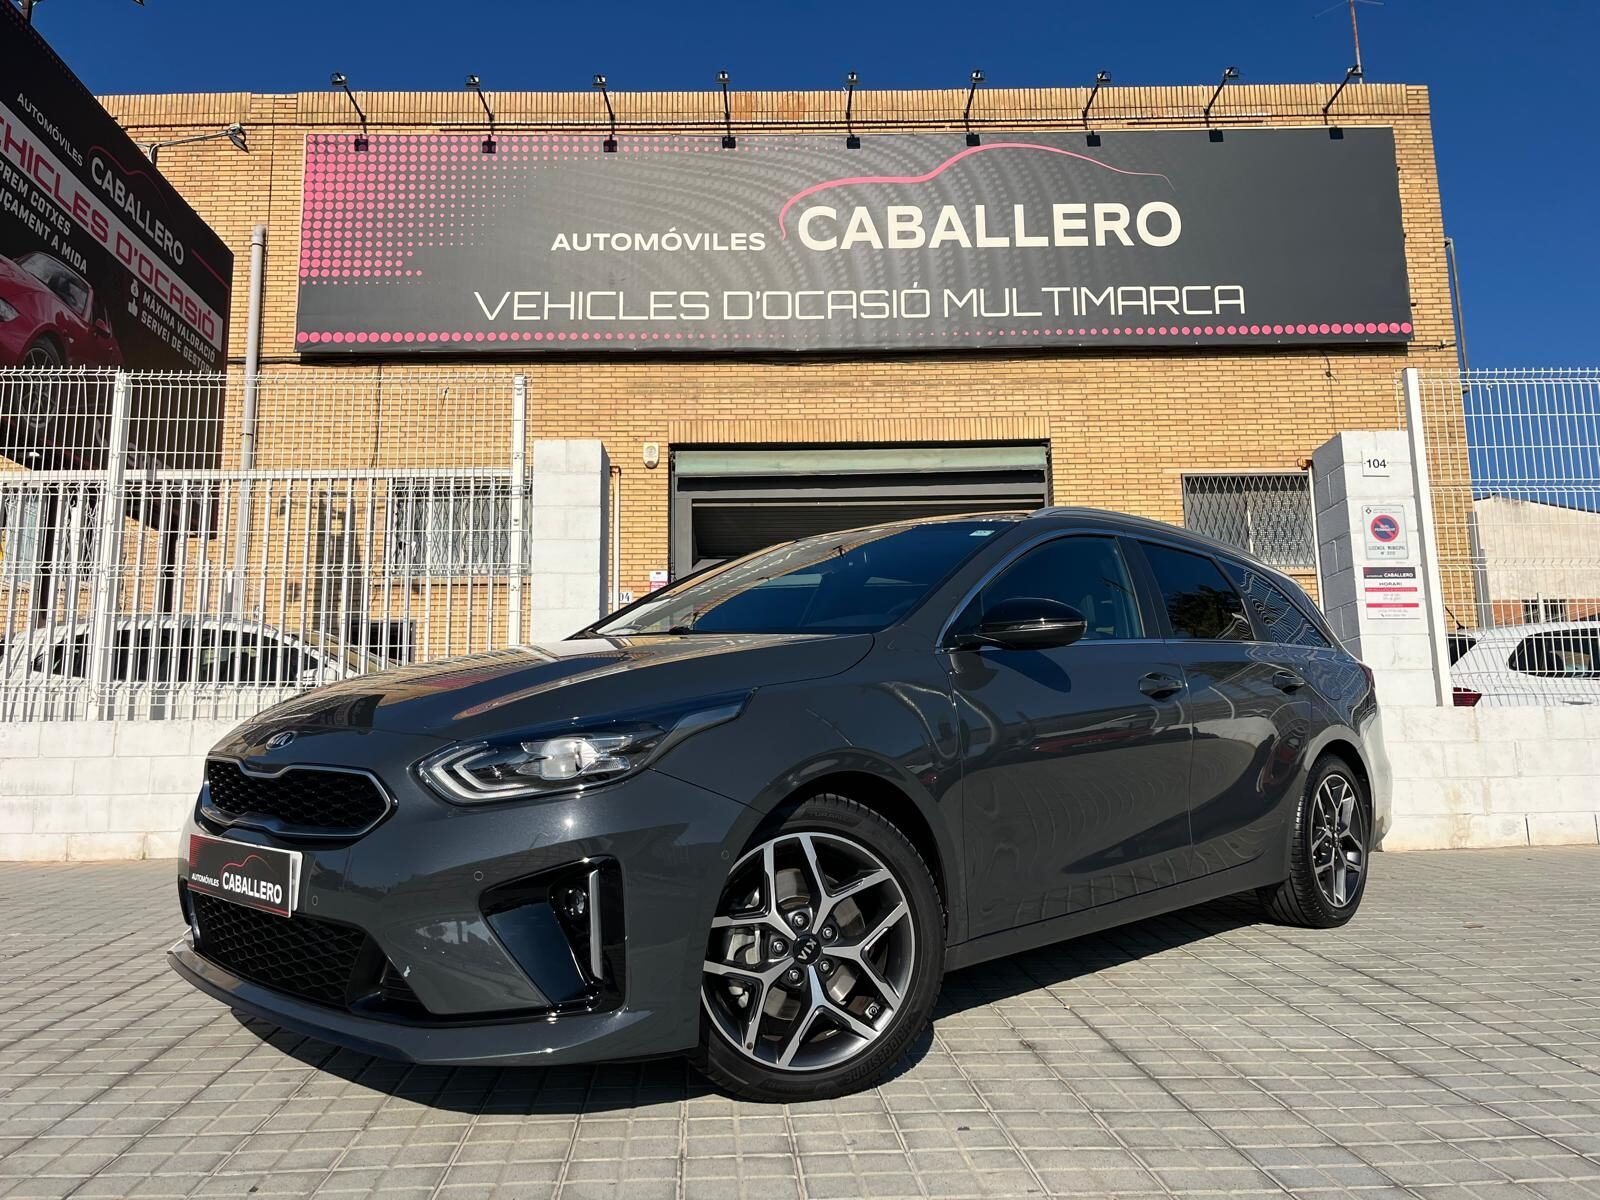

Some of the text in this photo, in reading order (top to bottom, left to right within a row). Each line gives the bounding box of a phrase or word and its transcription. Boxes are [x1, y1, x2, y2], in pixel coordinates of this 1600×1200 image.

[17, 93, 184, 265] AUTOMÓVILES CABALLERO
[0, 115, 215, 341] HICLES D'OCASIÓ
[30, 190, 71, 237] COTXES
[550, 201, 1182, 251] AUTOMÓVILES CABALLERO
[51, 234, 59, 251] A
[61, 241, 87, 275] MIDA
[474, 282, 1246, 321] VEHICLES D'OCASIÓ MULTIMARCA
[141, 310, 170, 343] SERVEI
[171, 335, 182, 353] DE
[177, 320, 216, 363] VALORACIÓ
[1366, 458, 1387, 469] 104
[191, 871, 283, 905] AUTOMÓVILES CABALLERO
[798, 938, 817, 960] KIA
